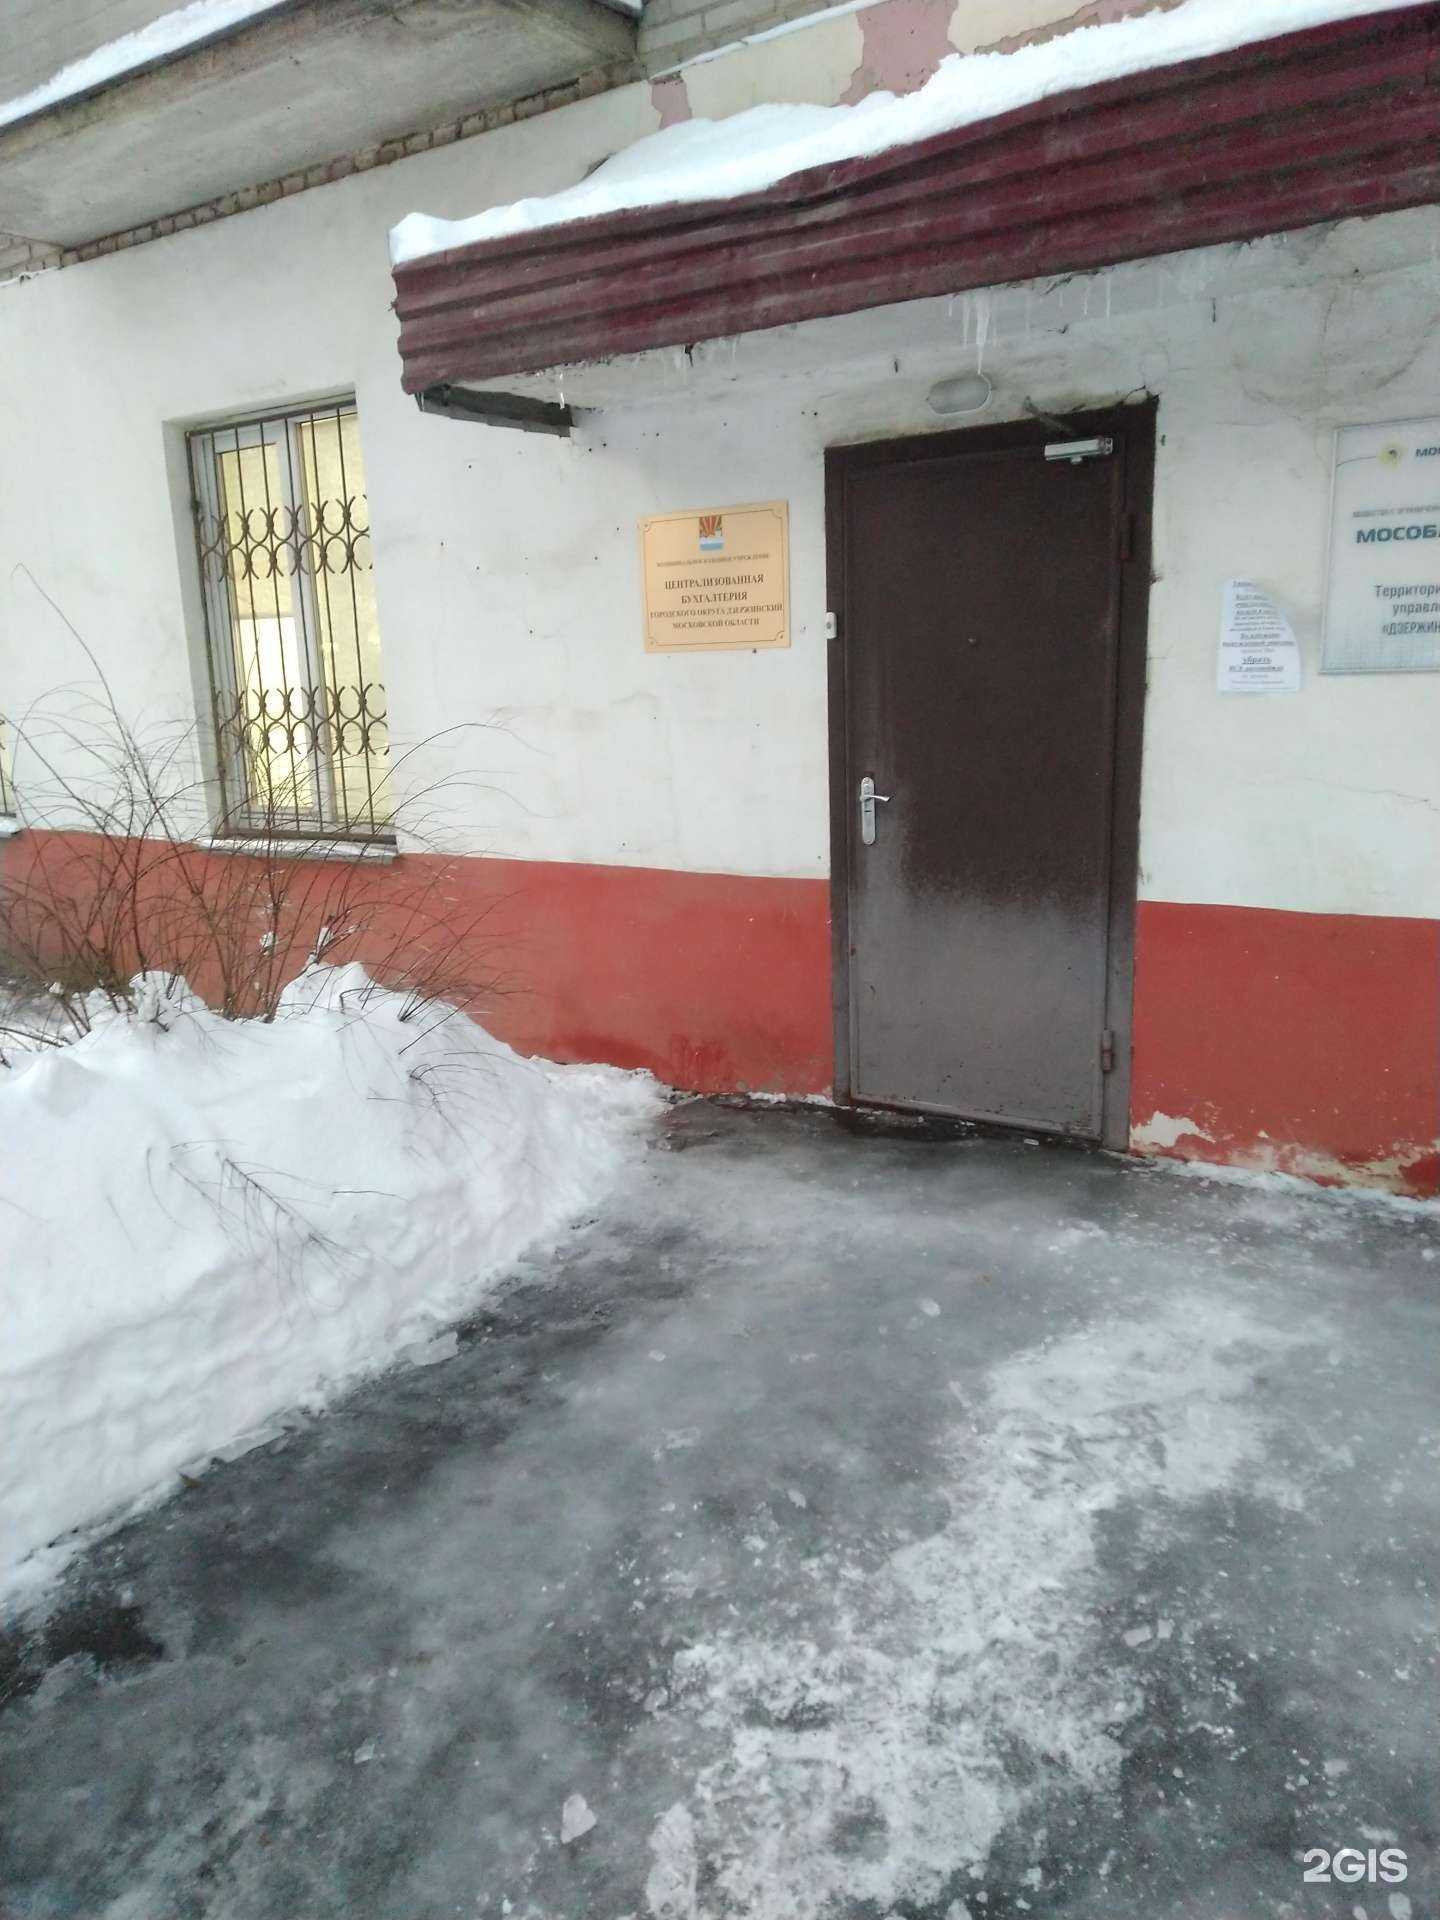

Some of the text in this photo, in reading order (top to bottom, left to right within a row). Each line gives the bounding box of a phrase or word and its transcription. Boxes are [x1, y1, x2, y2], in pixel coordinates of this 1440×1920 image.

[1416, 447, 1440, 457] МО
[1356, 525, 1440, 543] МОСОБ
[665, 574, 764, 590] ЦЕНТРАЛИЗОВАННАЯ
[681, 591, 748, 604] БУХГАЛТЕРИЯ
[1392, 602, 1440, 616] управл
